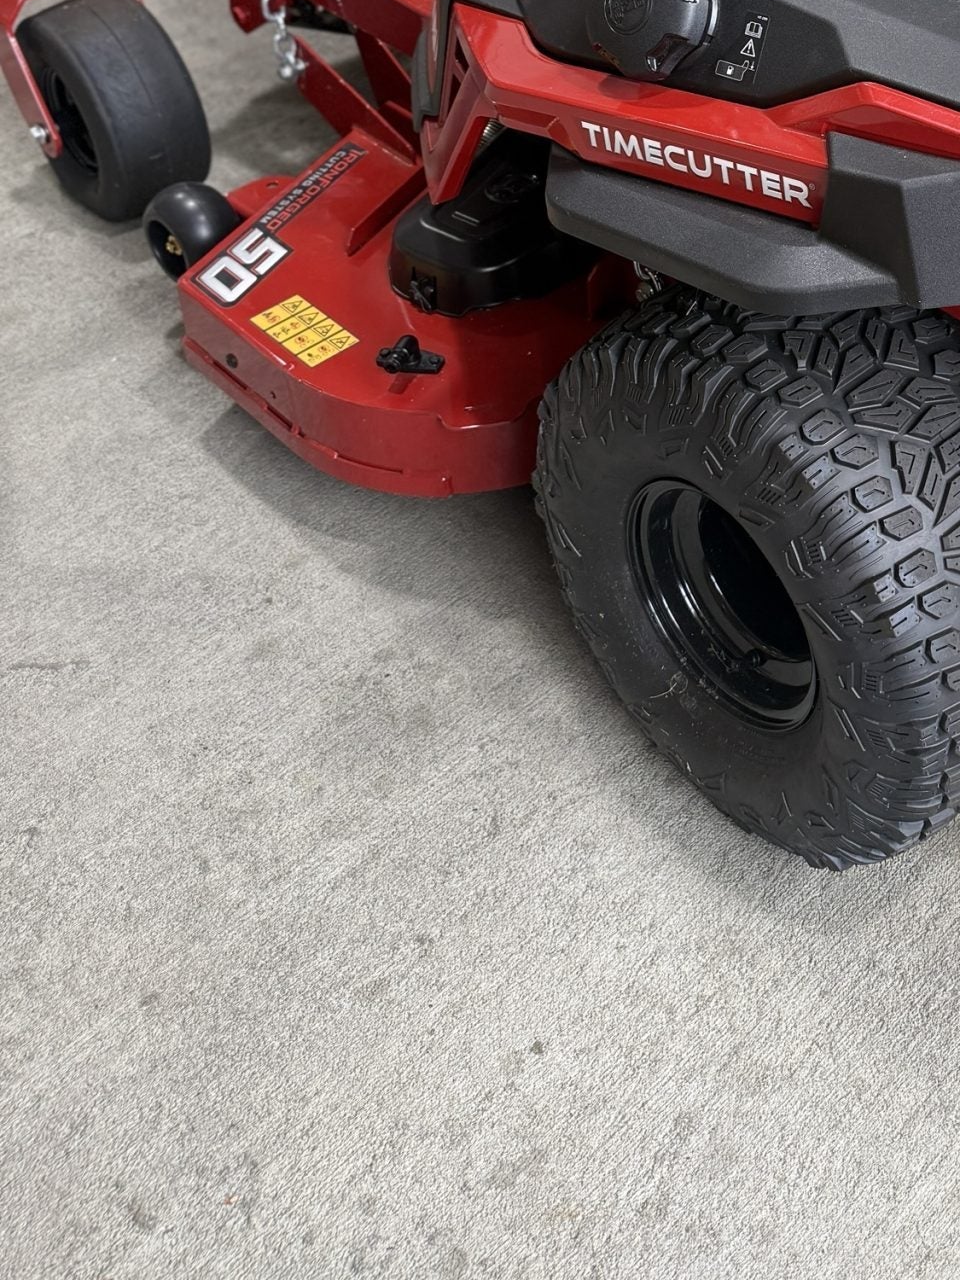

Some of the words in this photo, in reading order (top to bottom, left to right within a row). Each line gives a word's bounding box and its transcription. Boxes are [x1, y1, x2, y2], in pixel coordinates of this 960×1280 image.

[302, 151, 347, 187] CUTTING
[581, 121, 813, 210] TIMECUTTER
[260, 188, 303, 224] SYSTEM
[197, 227, 289, 304] 50
